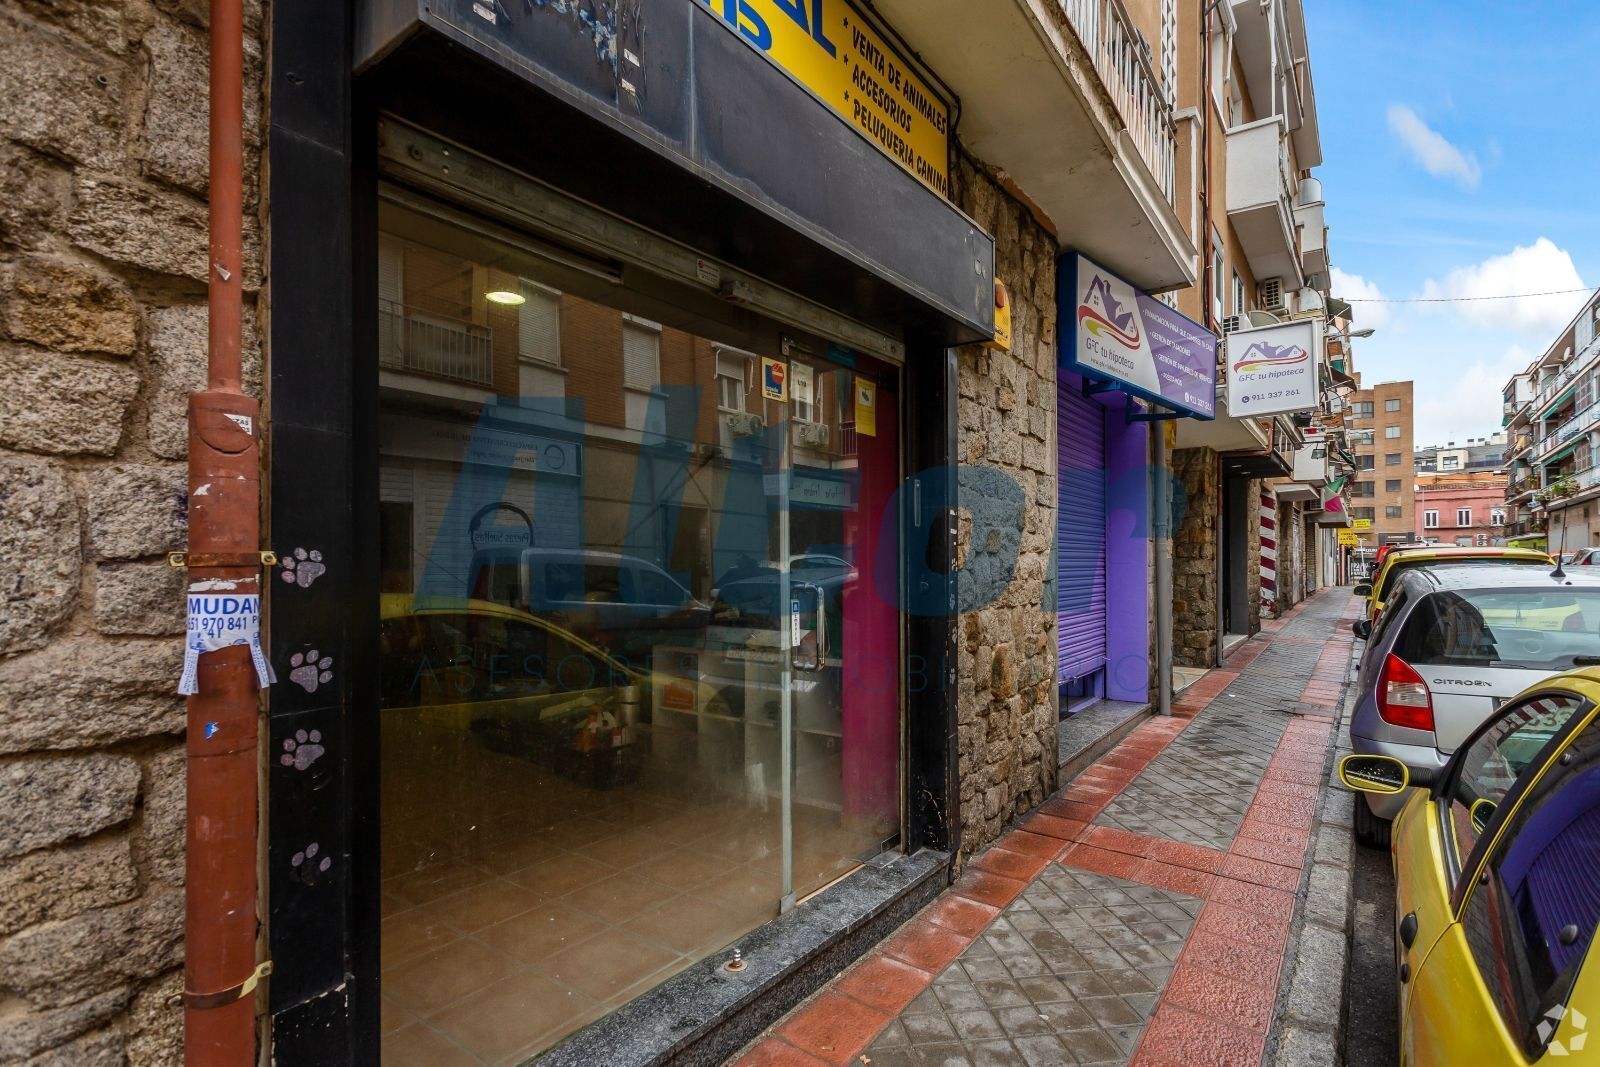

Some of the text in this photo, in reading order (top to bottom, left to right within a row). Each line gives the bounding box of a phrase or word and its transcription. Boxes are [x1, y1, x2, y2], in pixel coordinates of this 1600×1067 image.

[853, 25, 946, 135] VENTA DE ANIMALES
[853, 64, 912, 133] ACCESORIOS
[854, 98, 947, 197] PELUQUERIA CANINA
[1086, 337, 1099, 353] GFC
[1101, 346, 1107, 358] tu
[1108, 349, 1134, 370] hipoteca
[1239, 367, 1304, 382] GFC tu hipoteca
[1268, 391, 1282, 399] 337
[202, 617, 224, 630] 970
[227, 617, 247, 630] 841
